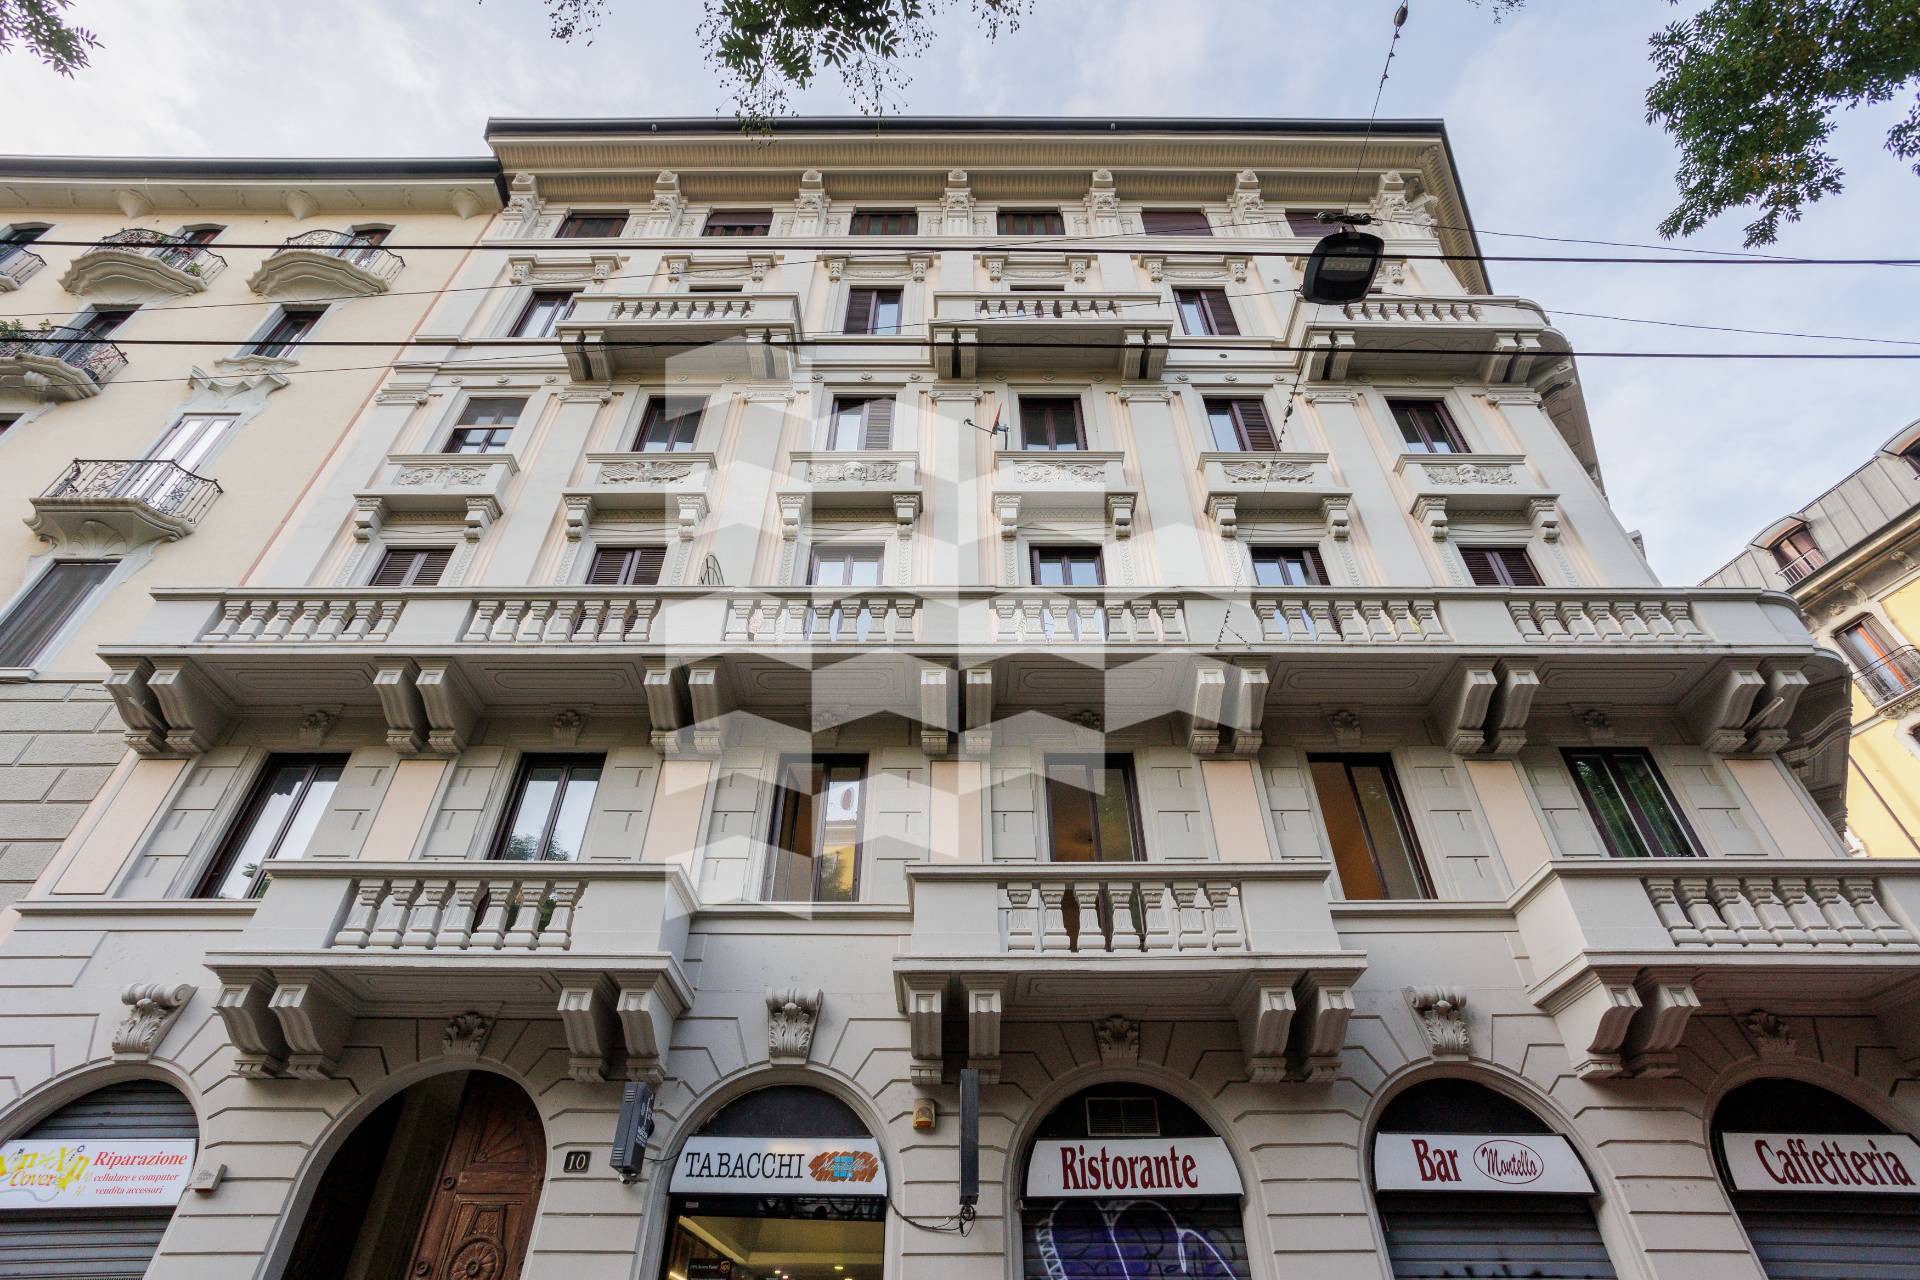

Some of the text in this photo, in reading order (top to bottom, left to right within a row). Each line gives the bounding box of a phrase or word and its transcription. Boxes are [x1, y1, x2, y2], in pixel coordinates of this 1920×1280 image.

[93, 1151, 188, 1170] Riparazione
[567, 1153, 586, 1170] 10
[685, 1152, 805, 1179] TABACCHI
[1060, 1144, 1198, 1190] Ristorante
[1411, 1138, 1462, 1182] Bar
[1481, 1146, 1537, 1177] Montello
[1754, 1138, 1916, 1186] Caffetteria
[93, 1172, 131, 1182] cellulare
[138, 1173, 180, 1183] computer
[95, 1185, 164, 1195] vendita accessori
